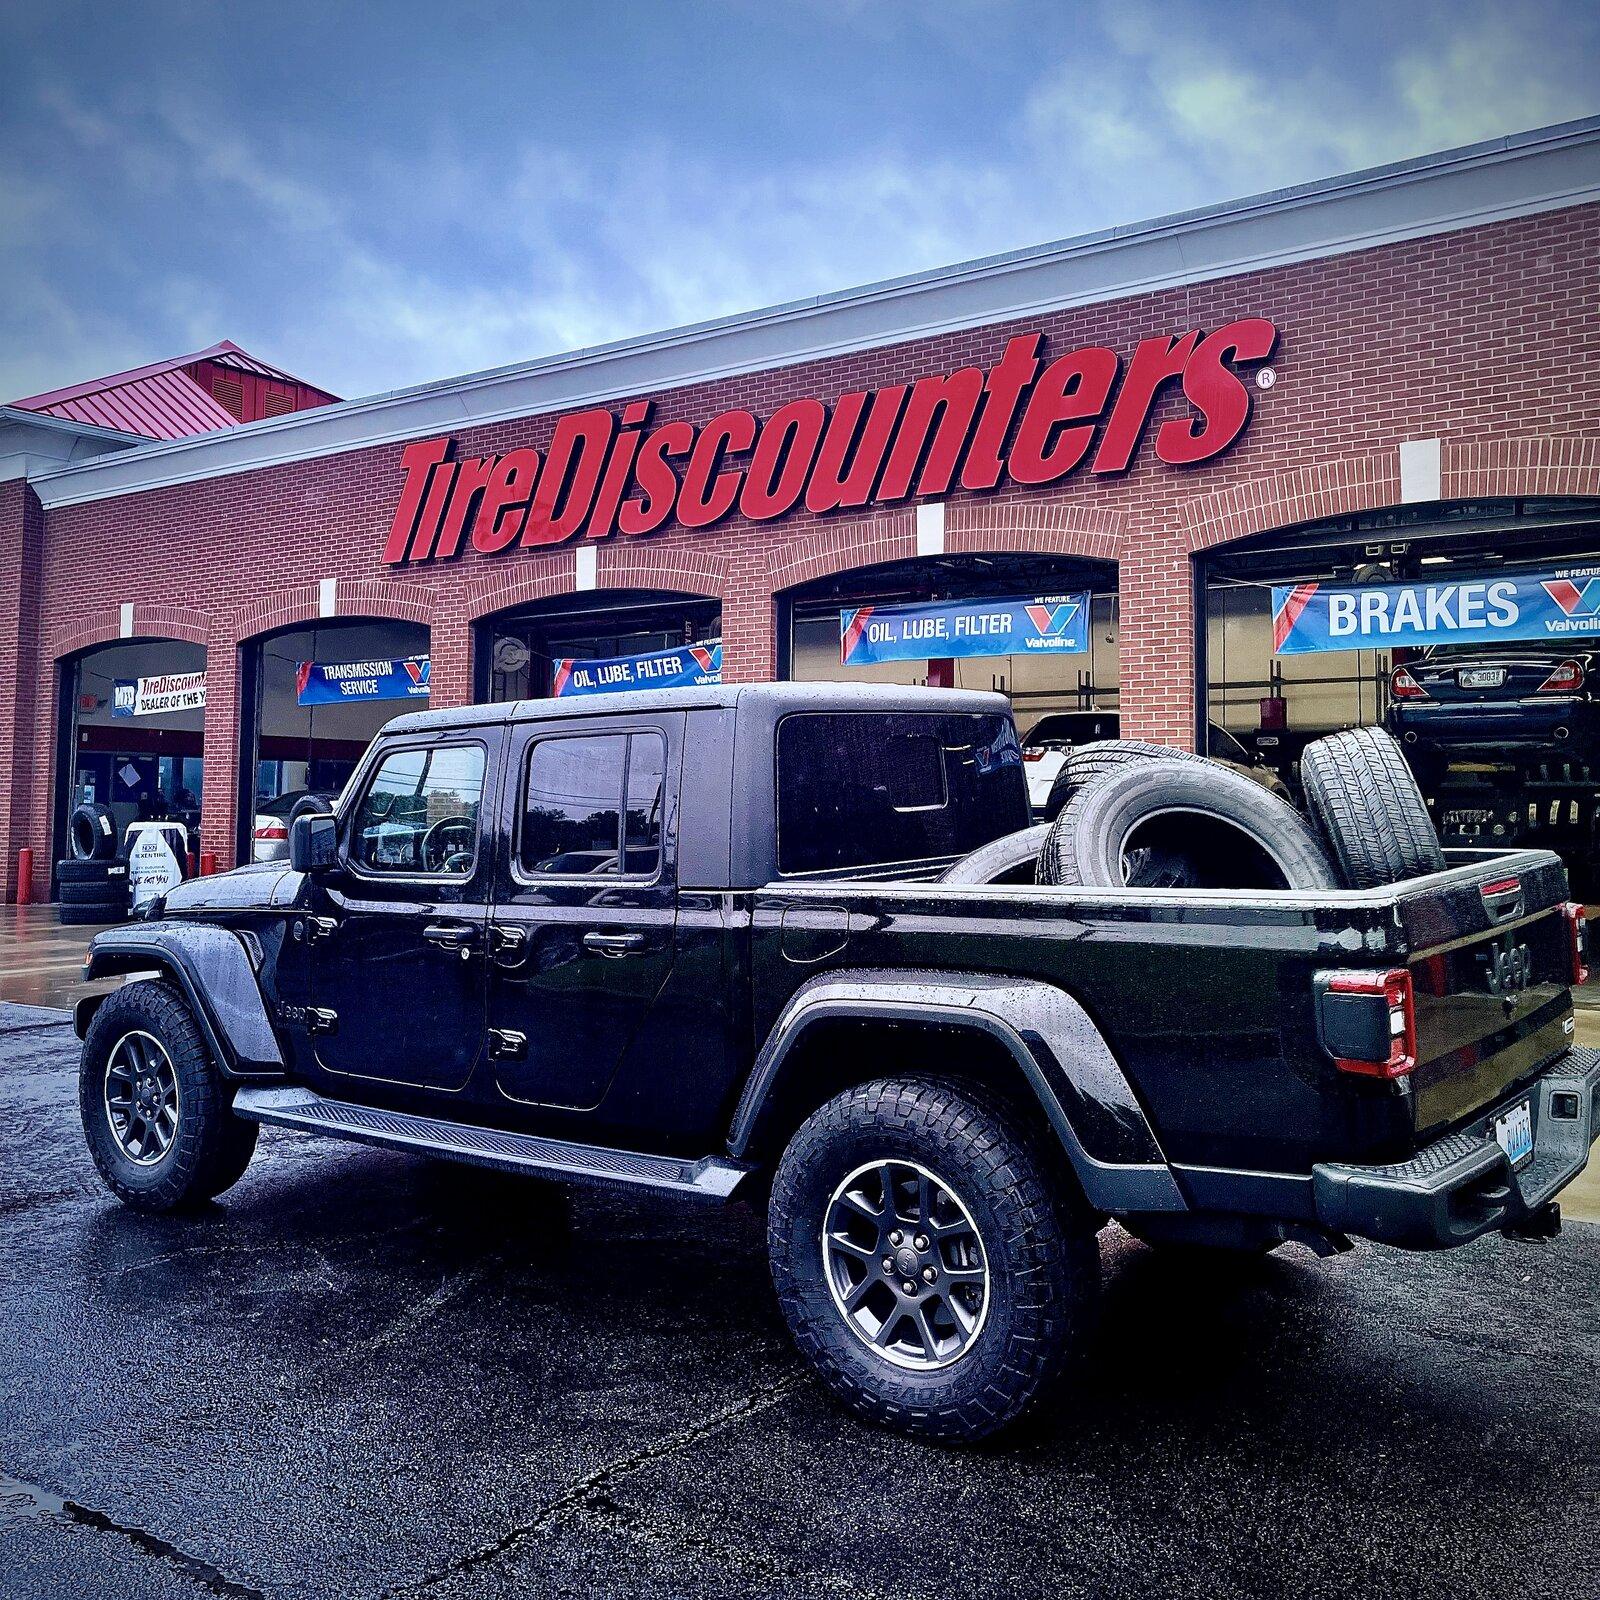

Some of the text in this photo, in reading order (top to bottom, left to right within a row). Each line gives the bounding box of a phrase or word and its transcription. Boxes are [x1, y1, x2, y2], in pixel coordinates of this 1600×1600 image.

[380, 318, 1278, 564] TireDiscounters
[1554, 570, 1569, 578] WE
[1045, 595, 1071, 603] FEATURE
[1328, 582, 1520, 636] BRAKES
[868, 613, 1013, 643] OIL, LUBE, FILTER
[1545, 617, 1600, 632] Valvoli
[322, 660, 393, 680] TRANSMISSION
[573, 656, 683, 688] OIL, LUBE, FILTER
[340, 679, 379, 696] SERVICE
[140, 696, 169, 711] DEALER
[170, 694, 182, 708] OF
[183, 691, 199, 705] THE
